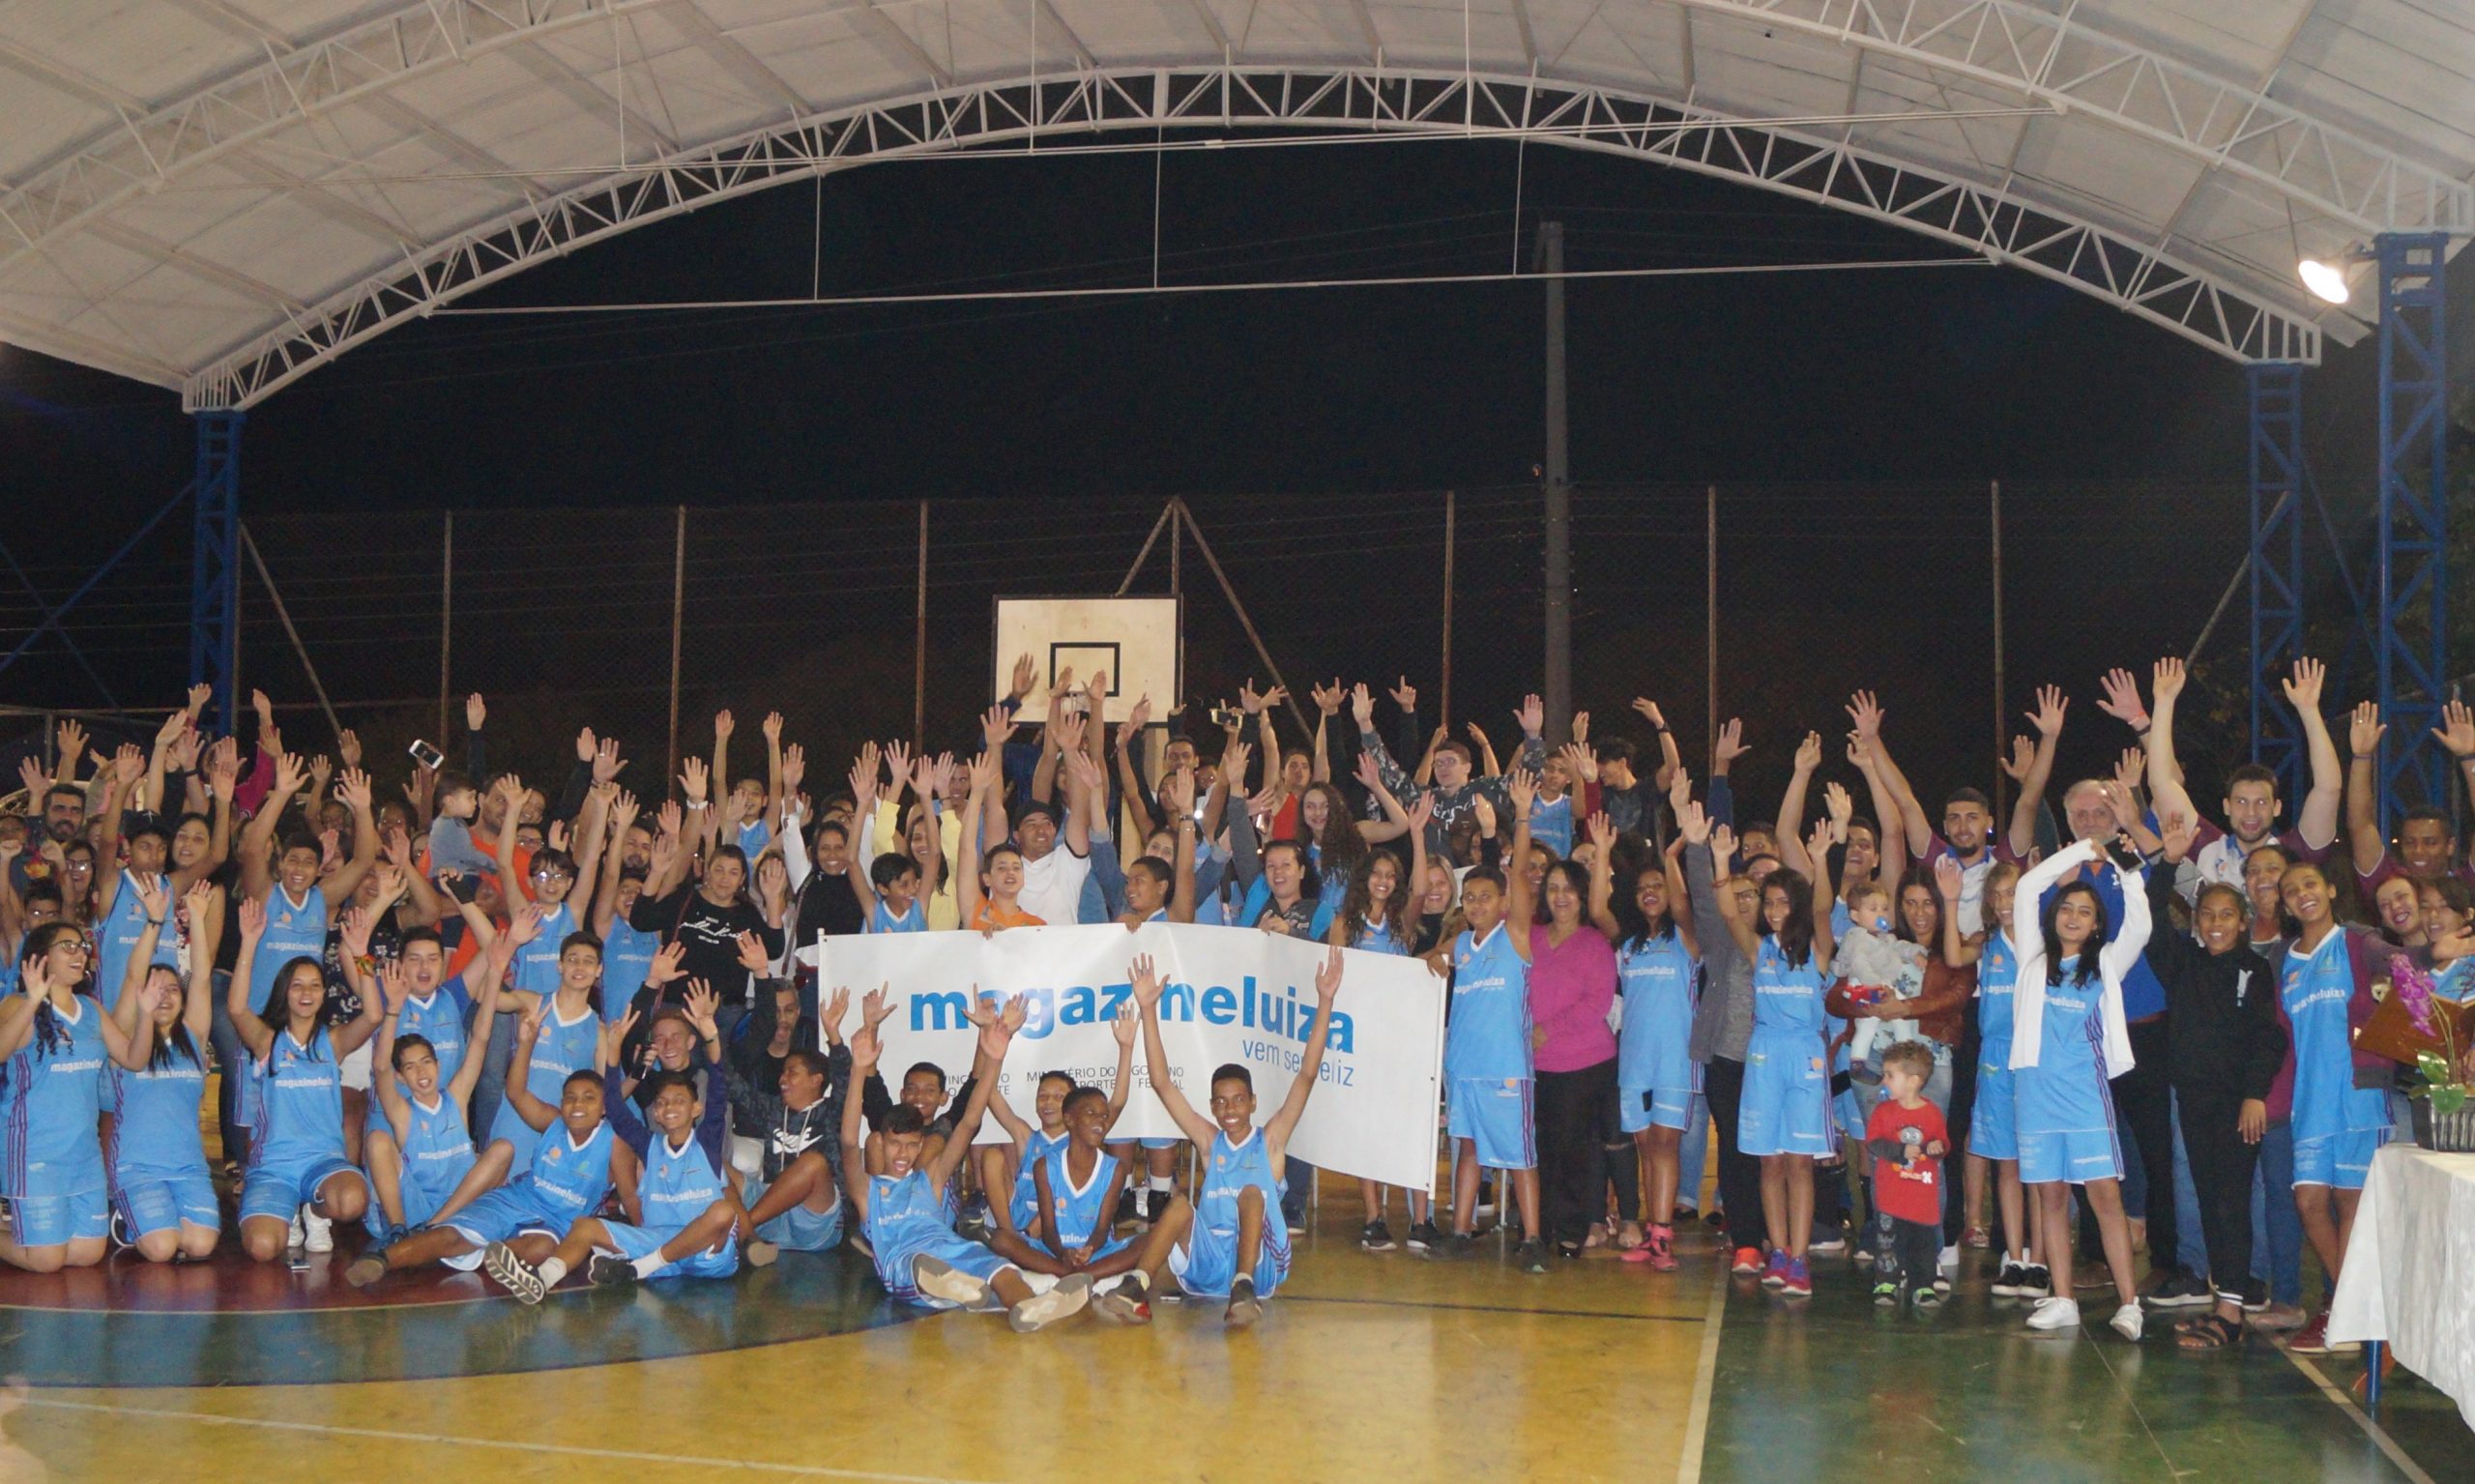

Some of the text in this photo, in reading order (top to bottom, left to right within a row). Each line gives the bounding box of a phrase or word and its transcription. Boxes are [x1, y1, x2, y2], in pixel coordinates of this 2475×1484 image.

[911, 975, 1354, 1055] mgazneluiza
[1131, 1064, 1184, 1077] GONO
[1242, 1039, 1354, 1088] vem se eliz
[1026, 1067, 1096, 1082] MIÉRIO
[1100, 1065, 1117, 1078] DO
[1138, 1078, 1184, 1090] FEAL
